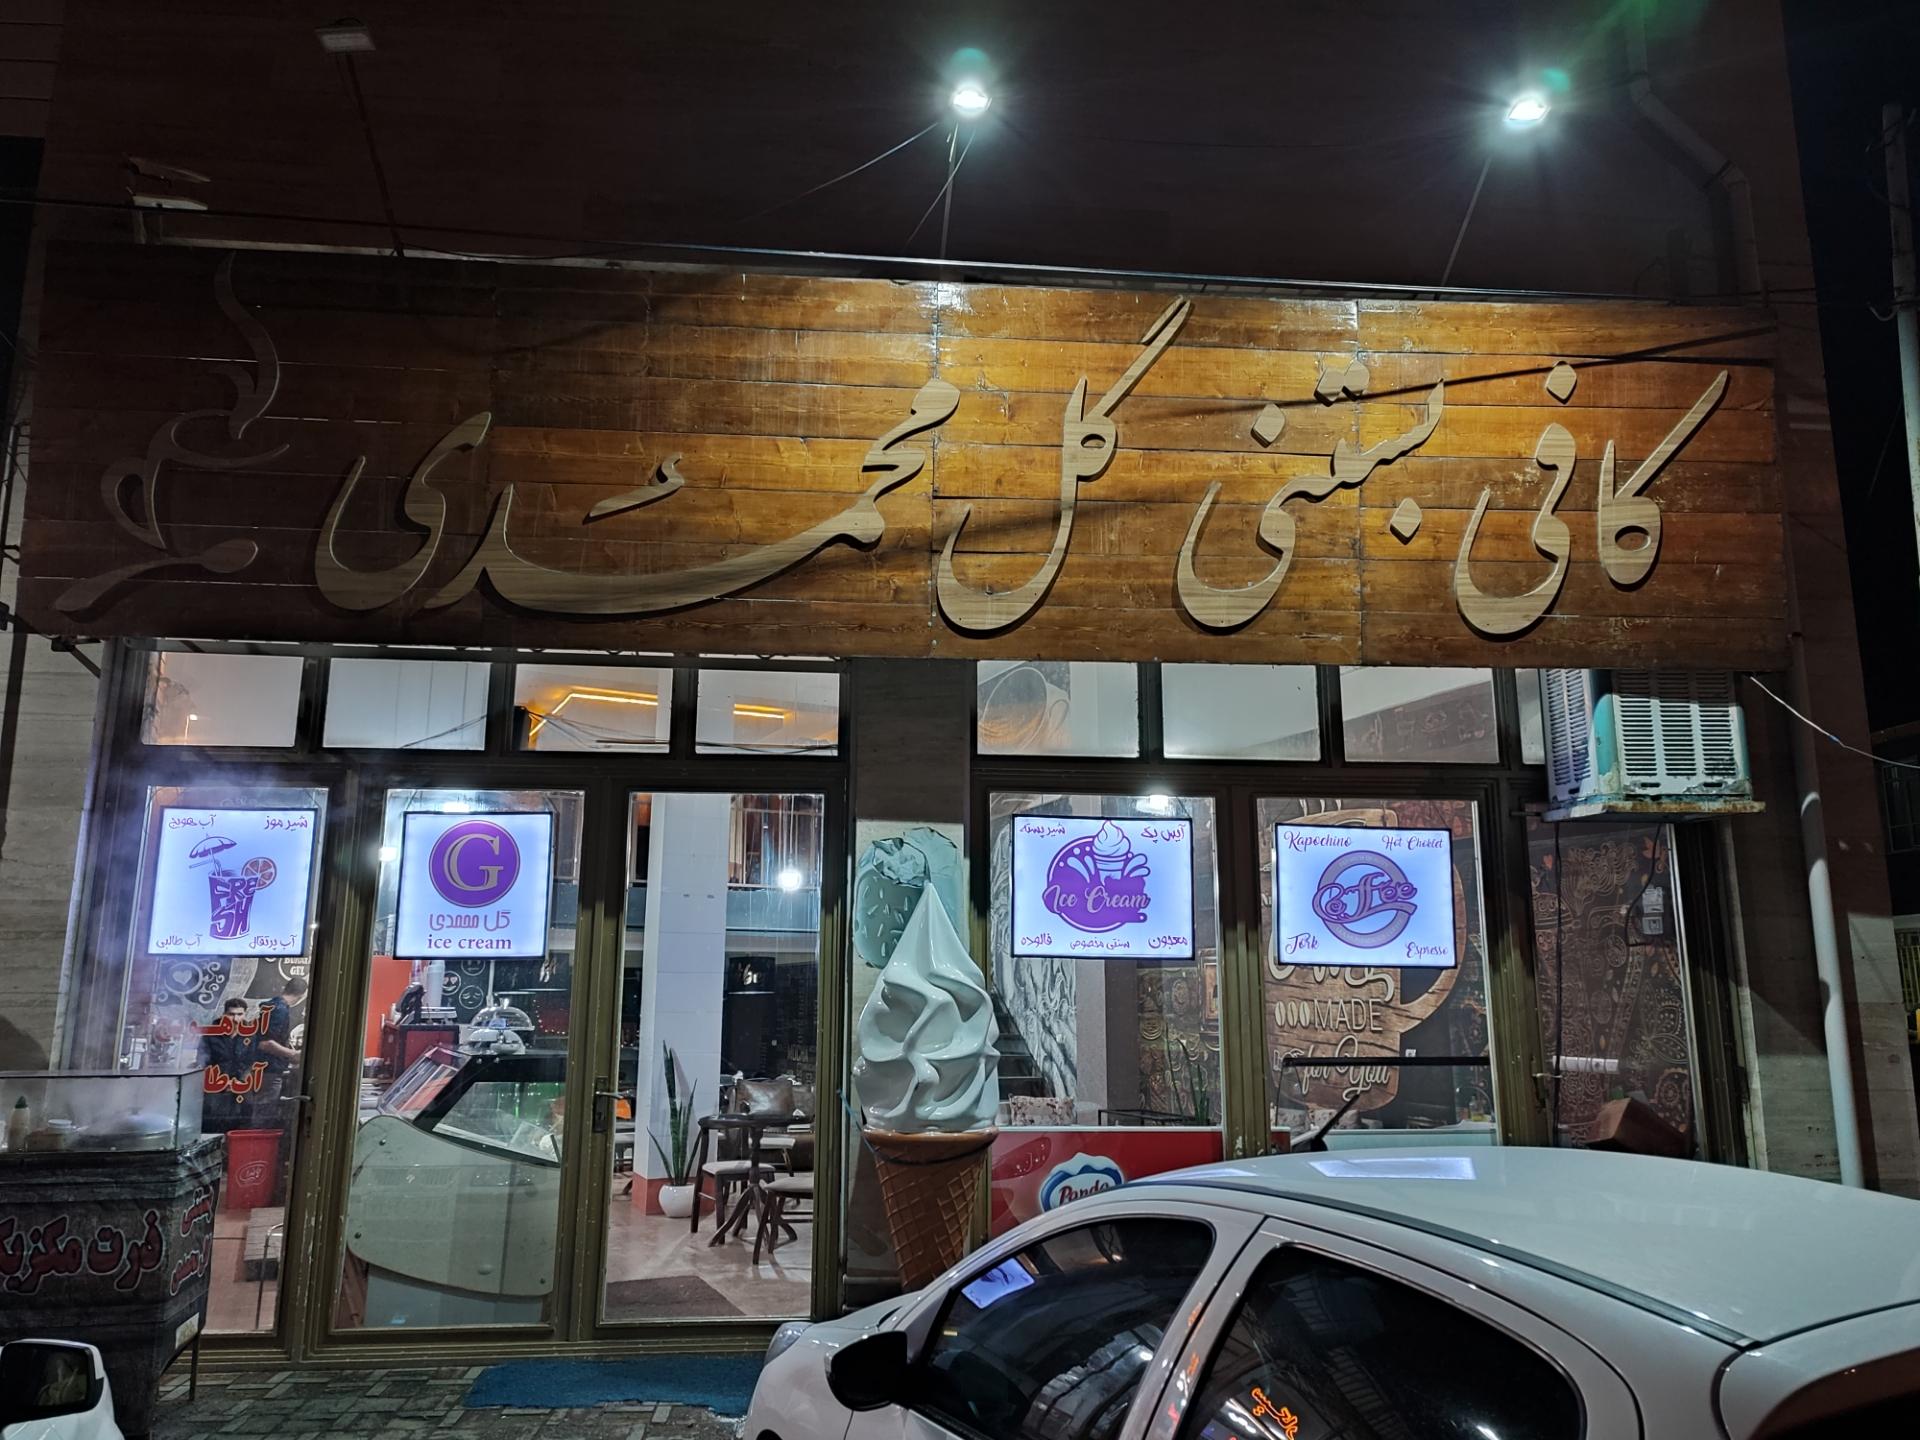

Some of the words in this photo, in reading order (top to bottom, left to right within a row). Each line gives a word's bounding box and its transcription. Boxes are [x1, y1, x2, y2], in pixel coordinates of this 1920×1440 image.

[937, 294, 1192, 632] گل
[315, 378, 961, 615] محمدی
[1177, 360, 1445, 630] بستنی
[1456, 361, 1730, 635] کافی
[169, 817, 198, 829] هویج
[199, 814, 216, 829] آب
[264, 816, 283, 830] موز
[287, 815, 308, 831] شیر
[1047, 823, 1066, 835] شیر
[1284, 830, 1352, 852] Kapochino
[1382, 835, 1403, 850] Hot
[443, 833, 504, 892] G
[1043, 884, 1078, 914] Ice
[1085, 885, 1150, 914] Cream
[1312, 872, 1417, 924] Coffee
[429, 912, 479, 931] محمدی
[484, 910, 512, 932] گل
[185, 934, 203, 948] آب
[249, 936, 278, 950] پرتقال
[279, 934, 297, 947] آب
[428, 934, 452, 949] ice
[458, 938, 512, 950] cream
[1021, 933, 1052, 948] فالوده
[1148, 935, 1188, 949] معجون
[1314, 998, 1384, 1032] MADE
[238, 1005, 275, 1045] آب
[230, 1062, 268, 1103] آب
